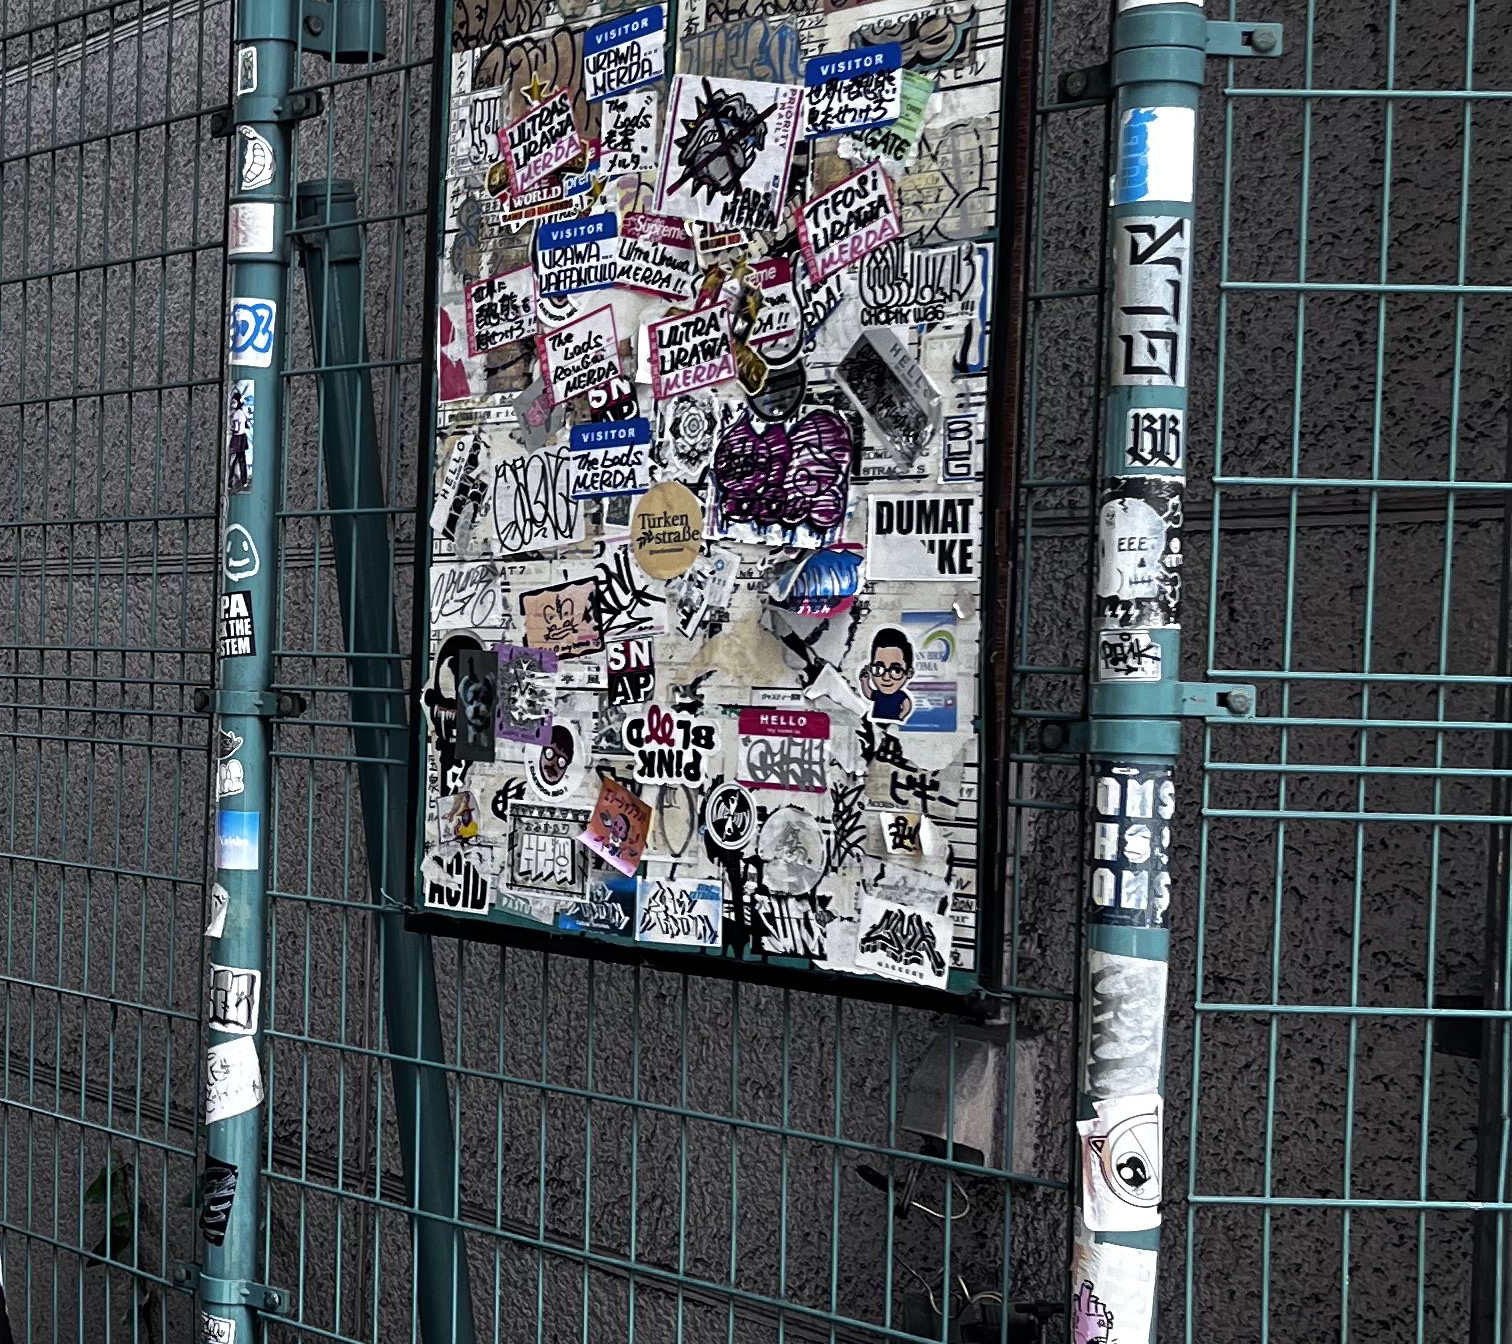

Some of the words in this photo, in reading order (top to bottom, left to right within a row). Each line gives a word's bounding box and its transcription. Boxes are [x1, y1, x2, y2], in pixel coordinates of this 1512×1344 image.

[595, 18, 649, 44] VISITOR
[820, 53, 884, 76] VISITOR
[509, 93, 569, 149] ULTRAS
[774, 102, 787, 135] MAIL
[779, 88, 798, 150] PRIORITY
[514, 113, 576, 170] URAWA
[520, 139, 581, 186] MERDA
[511, 186, 562, 209] WORLD
[635, 215, 688, 241] Supreme
[721, 202, 776, 230] MERDA
[812, 194, 890, 254] URAWA
[551, 222, 604, 241] VISITOR
[820, 218, 896, 275] MERDA
[548, 331, 574, 352] The
[660, 333, 731, 375] URAWA
[564, 360, 619, 398] MERDA
[663, 358, 732, 396] MERDA
[581, 427, 636, 443] VISITOR
[440, 441, 466, 500] HELLO
[572, 452, 599, 471] The
[637, 510, 689, 530] Türken
[874, 498, 975, 536] DUMAT
[653, 525, 701, 545] straße
[228, 617, 253, 637] THE
[759, 714, 808, 727] HELLO
[428, 851, 489, 911] ACID
